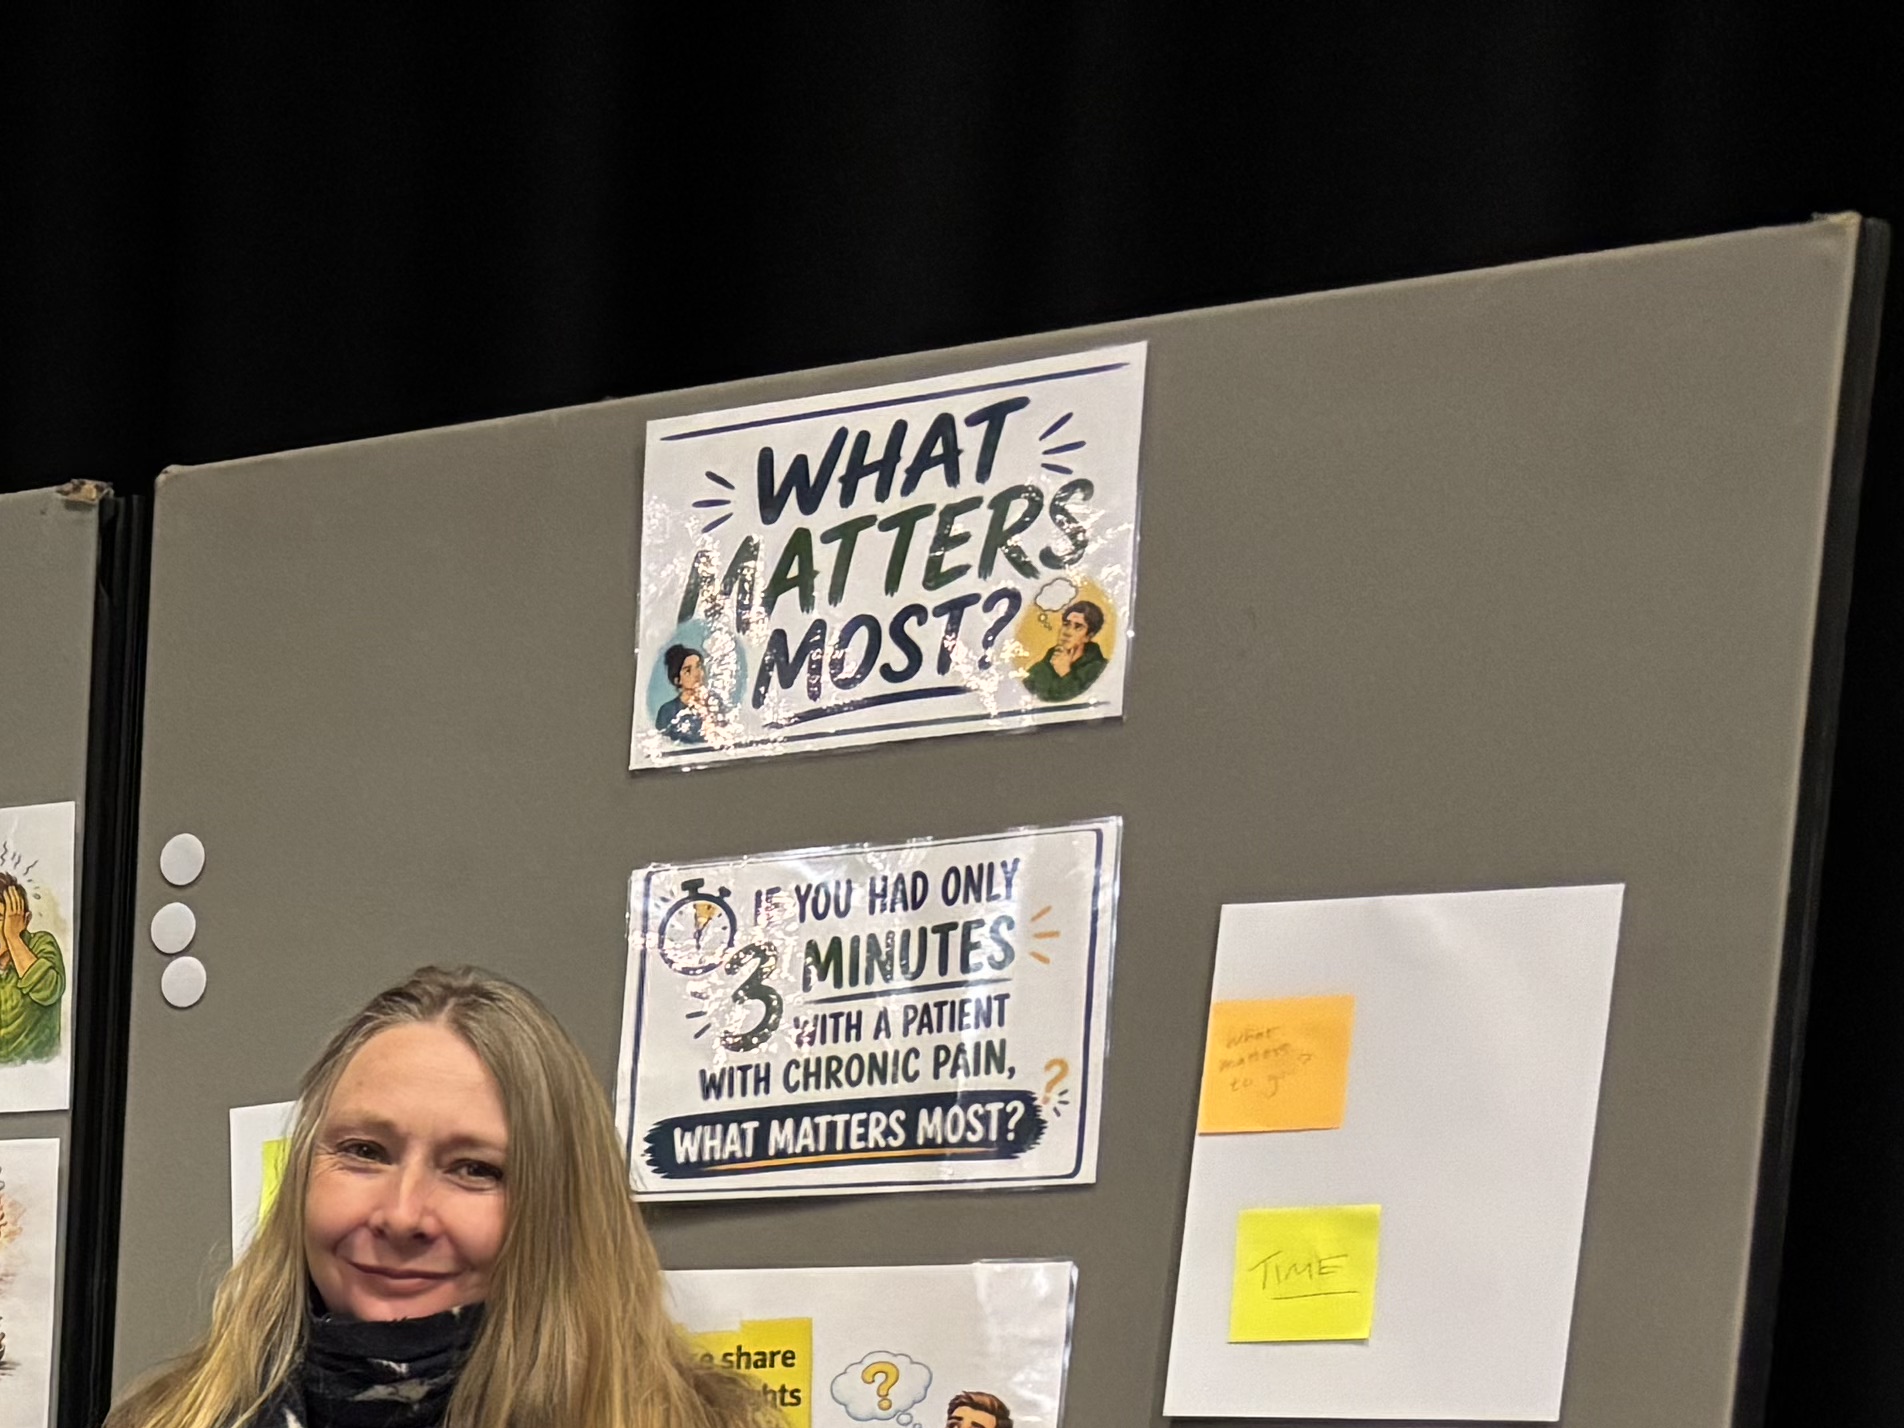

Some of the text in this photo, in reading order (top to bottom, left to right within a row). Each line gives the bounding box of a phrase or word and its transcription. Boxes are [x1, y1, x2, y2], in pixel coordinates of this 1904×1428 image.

[757, 397, 1030, 525] WHAT
[678, 479, 1094, 632] MATTERS
[752, 588, 1022, 707] MOST?
[754, 858, 1019, 926] IF YOU HAD ONLY
[720, 916, 1015, 1052] 3 MINUTES
[674, 1100, 1024, 1164] WHAT MATTERS MOST?
[721, 1344, 795, 1369] share
